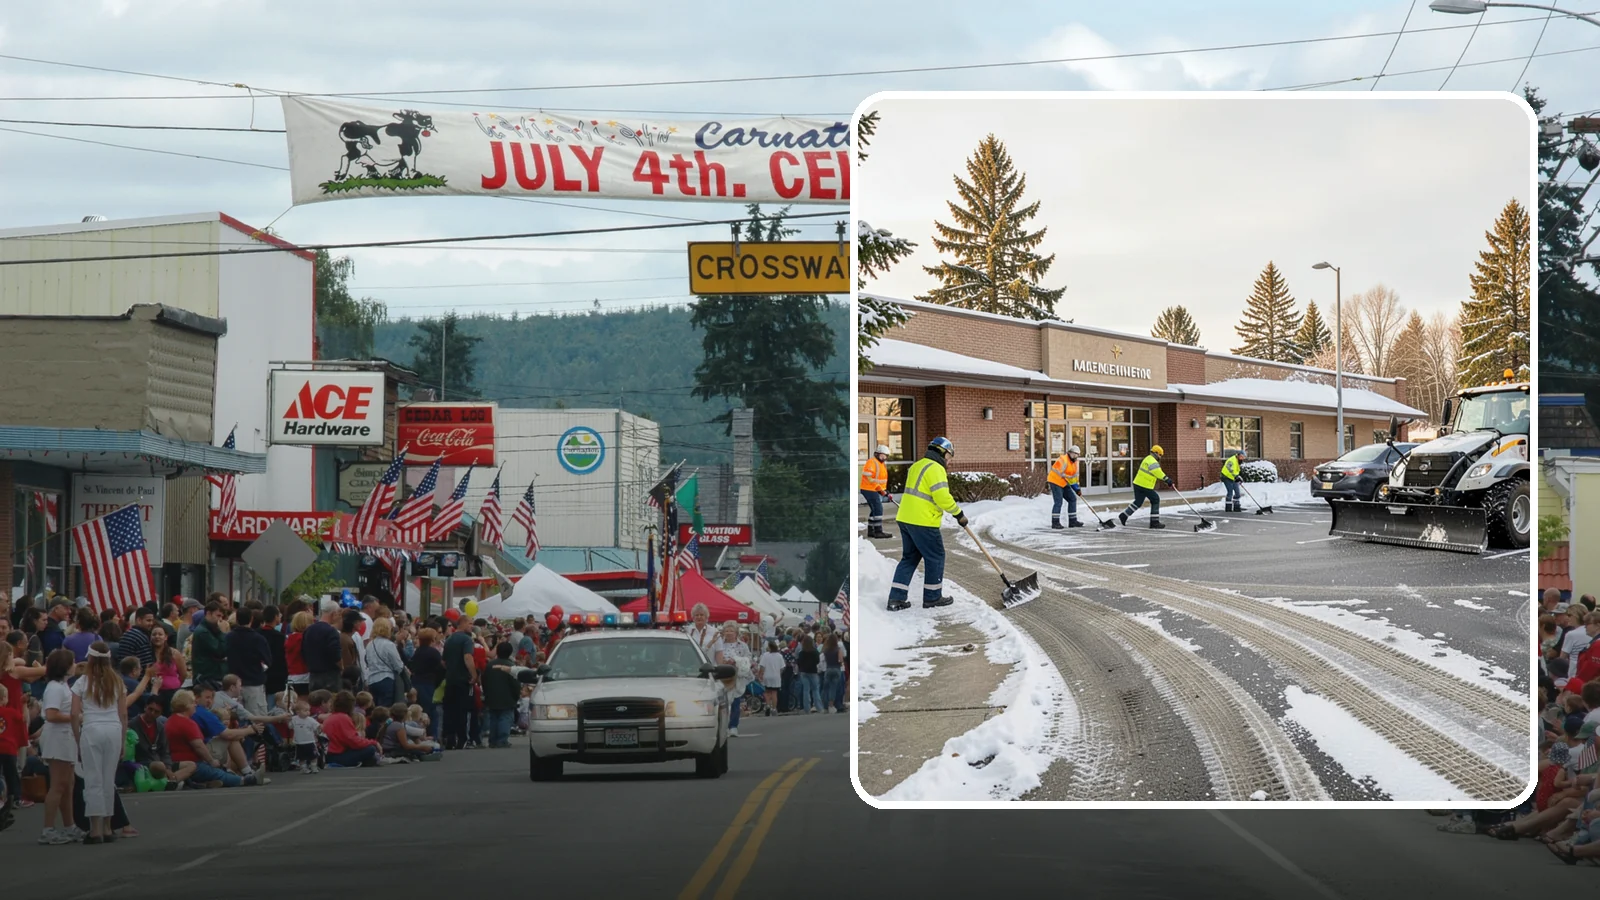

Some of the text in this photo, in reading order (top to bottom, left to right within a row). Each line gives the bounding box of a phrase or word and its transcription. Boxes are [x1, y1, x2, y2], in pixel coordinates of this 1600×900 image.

[481, 141, 604, 192] JULY
[632, 150, 746, 197] 4th.
[697, 254, 850, 279] CROSSWA
[283, 380, 374, 420] ACE
[405, 409, 452, 422] CEDAR
[283, 421, 371, 437] Hardware
[416, 428, 477, 447] Coca-Cola
[95, 485, 124, 494] Vincent
[126, 486, 136, 494] de
[137, 486, 155, 495] Paul
[688, 526, 742, 535] CRNATION
